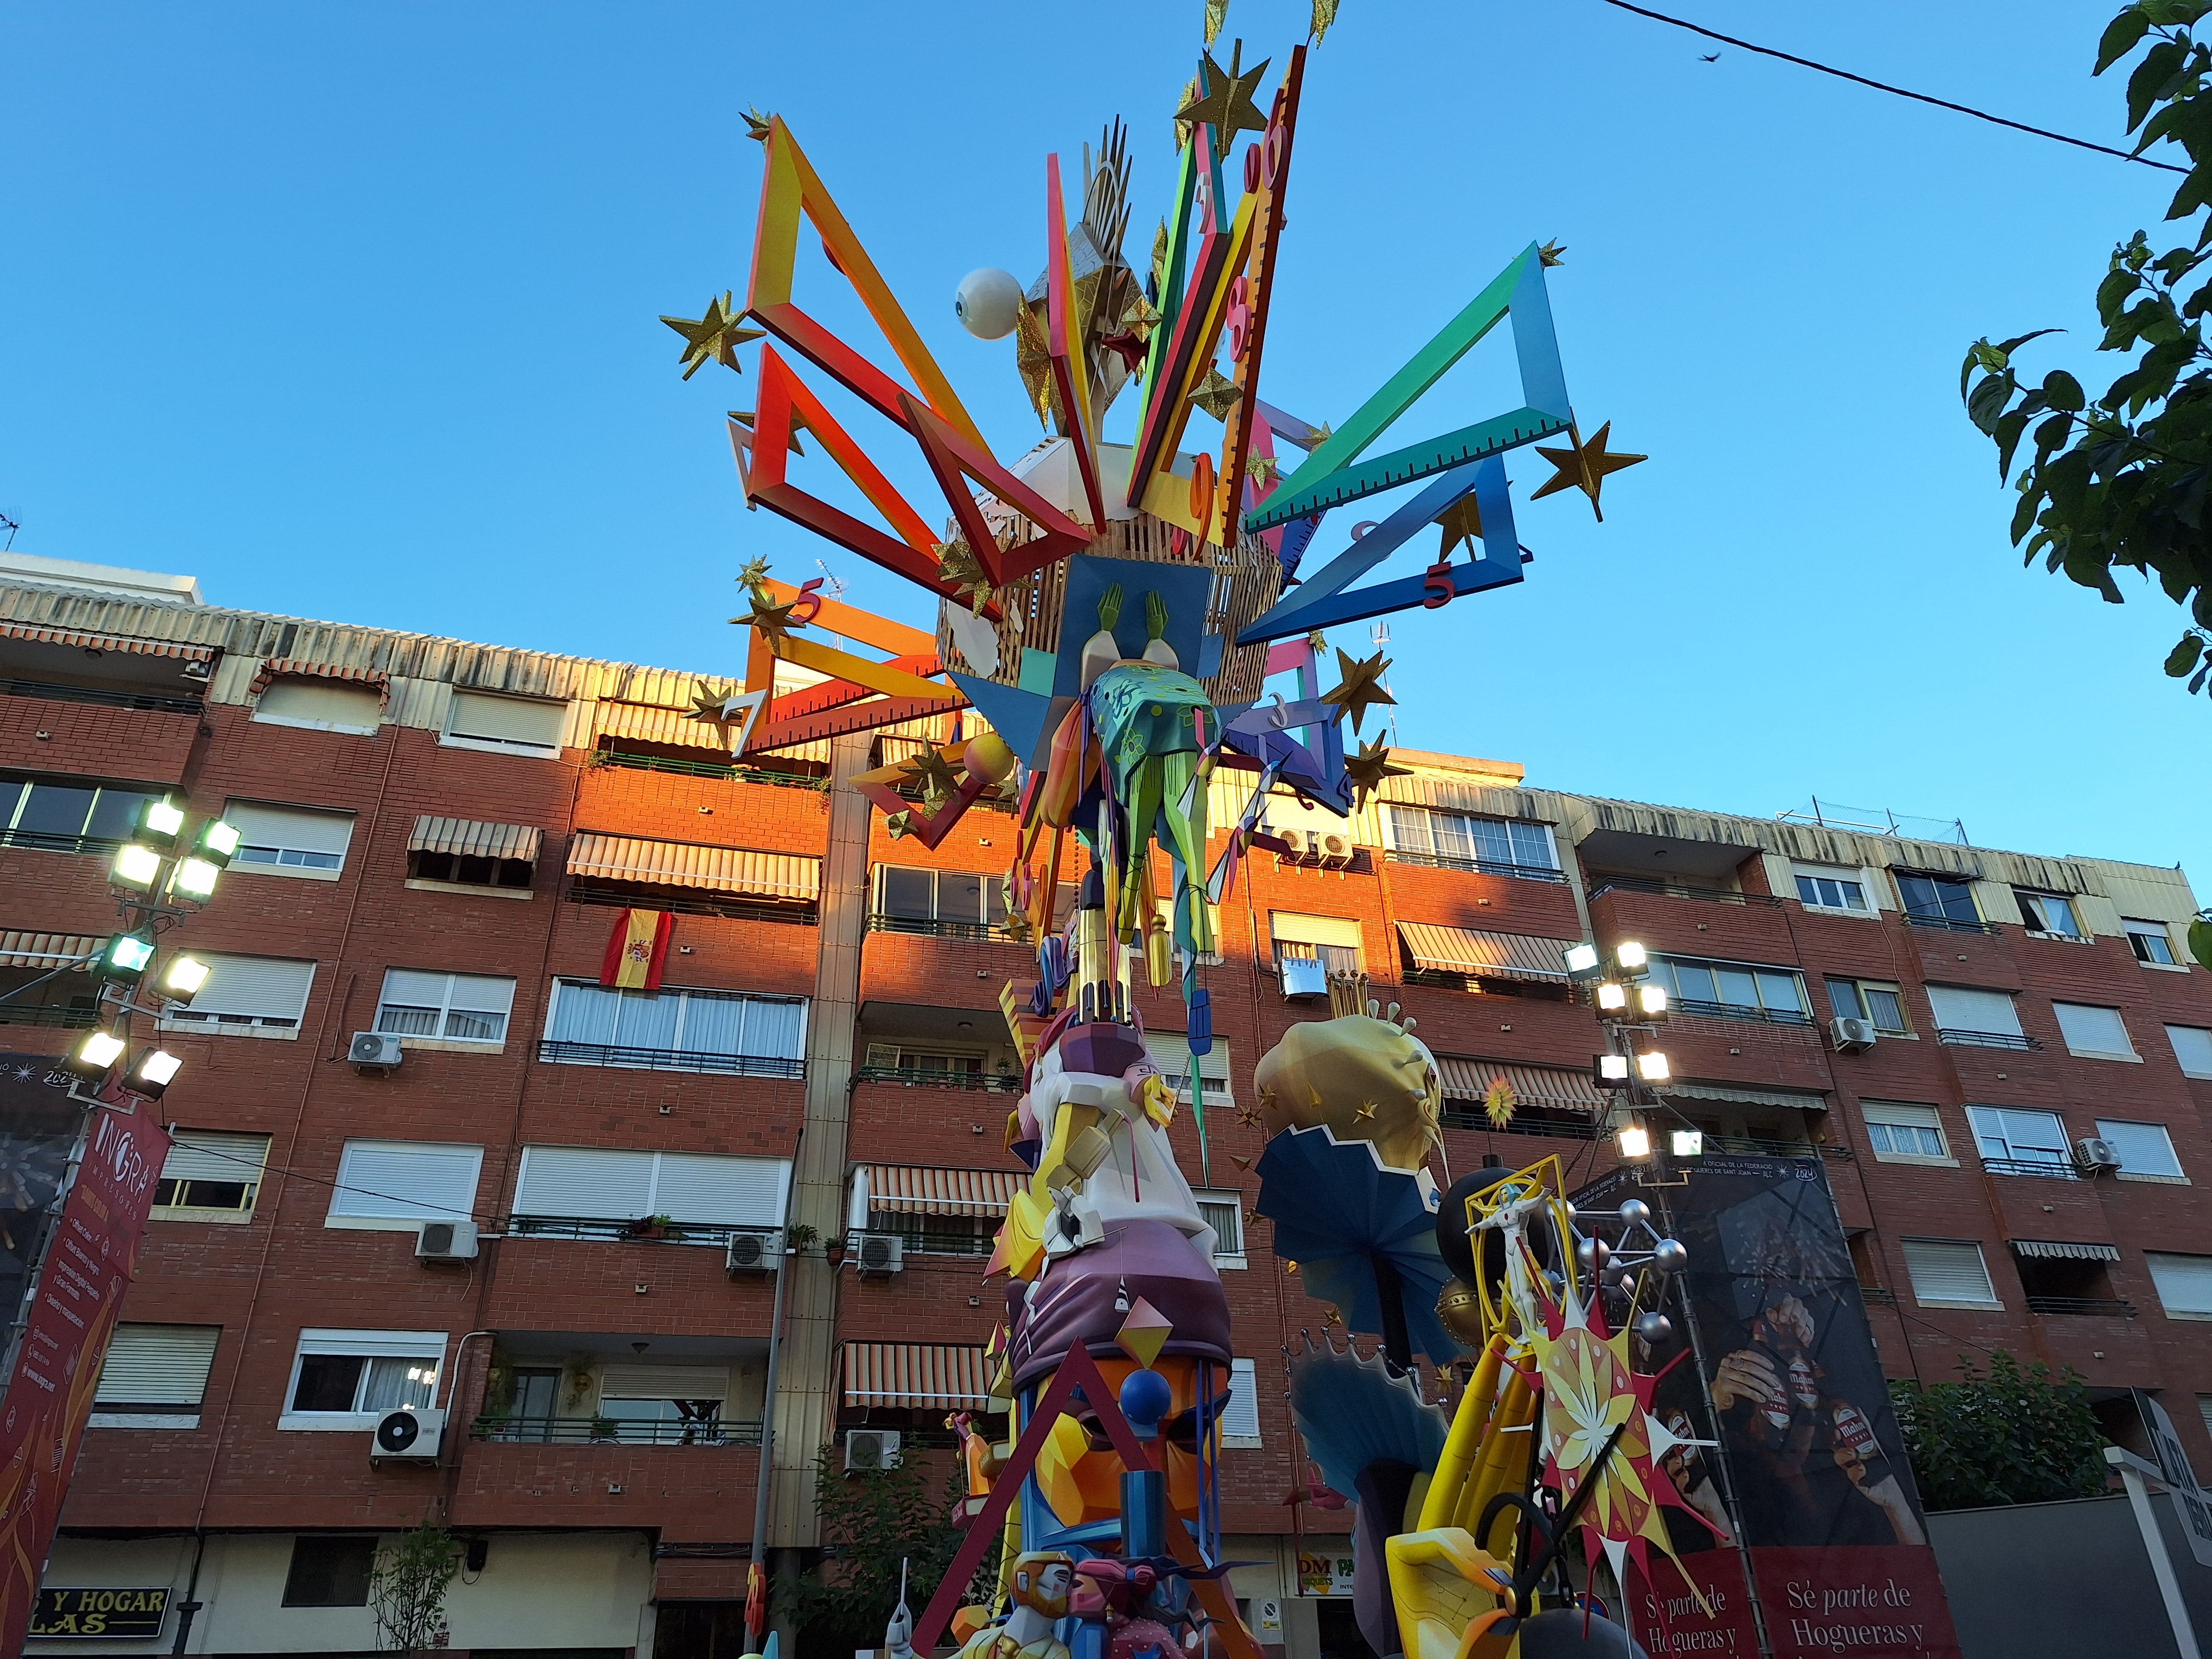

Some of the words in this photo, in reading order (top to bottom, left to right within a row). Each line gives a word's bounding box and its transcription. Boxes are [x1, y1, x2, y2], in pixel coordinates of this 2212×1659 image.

[1190, 453, 1214, 560] 9
[793, 577, 824, 623] 5
[1424, 561, 1455, 609] 5
[721, 689, 769, 759] 7
[1268, 692, 1288, 728] 3
[95, 1113, 149, 1204] INGRA
[1794, 1168, 1814, 1179] 2024
[88, 1160, 137, 1220] IMPRESORES
[54, 1591, 69, 1611] Y
[78, 1591, 164, 1612] HOGAR
[1667, 1591, 1703, 1624] parte
[1706, 1584, 1727, 1612] de
[1787, 1579, 1817, 1609] Sé
[1822, 1584, 1878, 1616] parte
[1883, 1578, 1912, 1607] de
[1726, 1628, 1736, 1655] y
[1790, 1618, 1908, 1654] Hogueras
[1909, 1624, 1923, 1651] y
